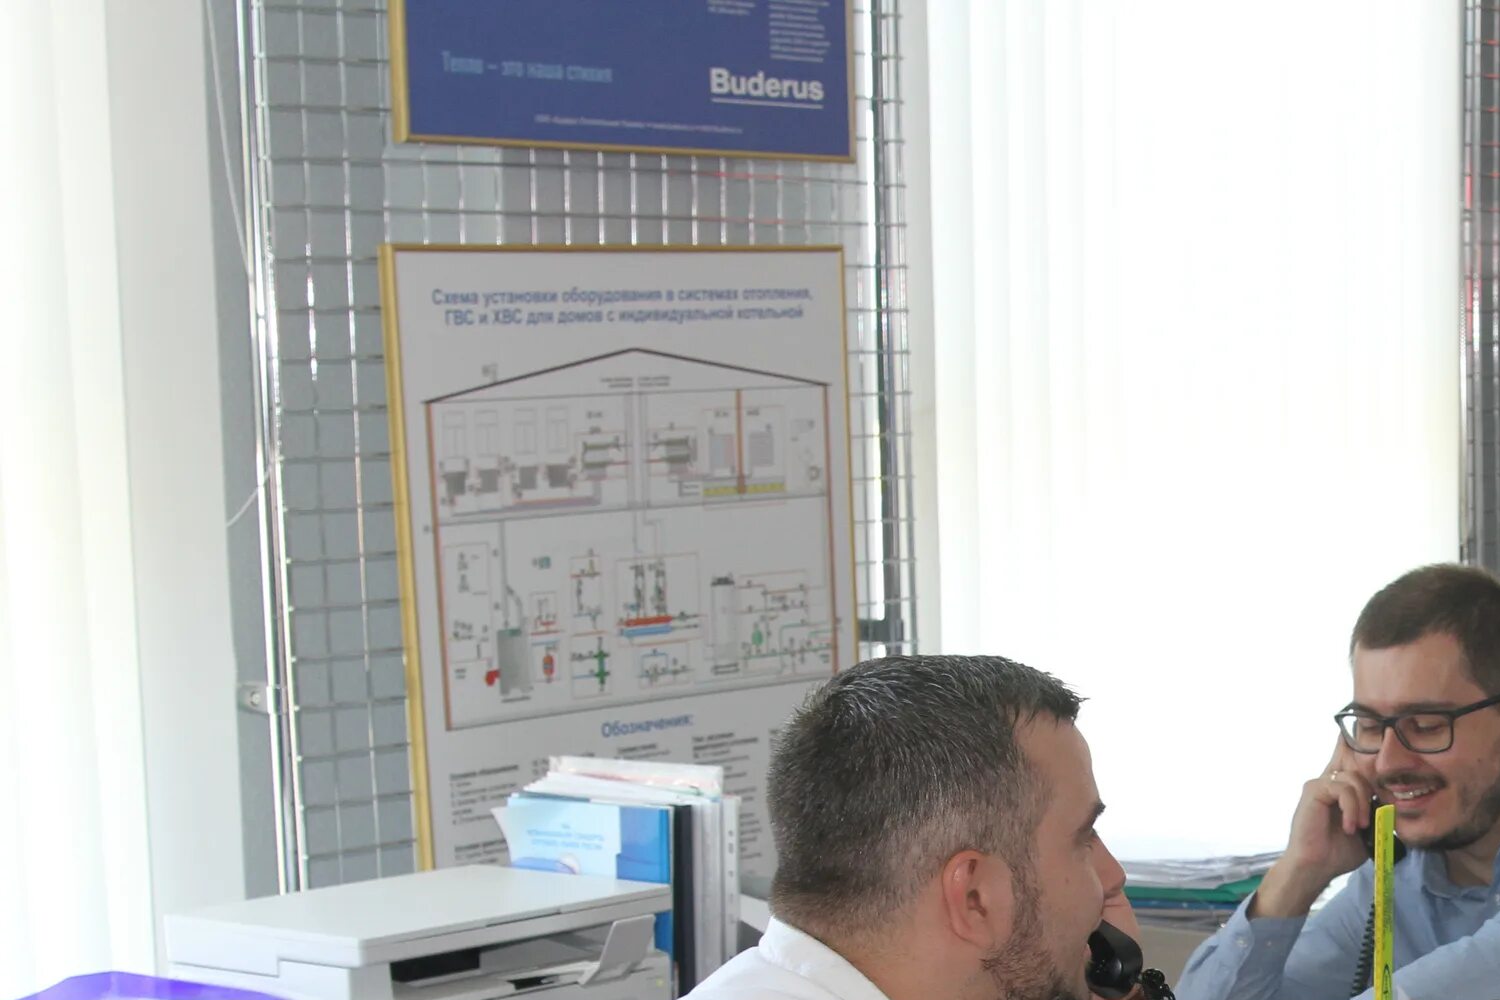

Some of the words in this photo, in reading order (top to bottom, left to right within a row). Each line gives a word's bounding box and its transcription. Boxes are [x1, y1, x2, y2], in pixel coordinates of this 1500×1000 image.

[442, 50, 484, 75] Тепло
[501, 60, 524, 77] это
[527, 62, 564, 81] наша
[710, 67, 825, 100] Buderus
[431, 289, 479, 305] Схема
[482, 290, 559, 307] установки
[562, 286, 663, 306] оборудования
[667, 289, 674, 301] в
[678, 289, 739, 302] системах
[445, 310, 475, 325] ГВС
[479, 312, 489, 324] и
[493, 308, 523, 324] ХВС
[526, 311, 554, 326] для
[557, 311, 603, 324] домов
[607, 311, 615, 323] с
[618, 305, 735, 325] индивидуальной
